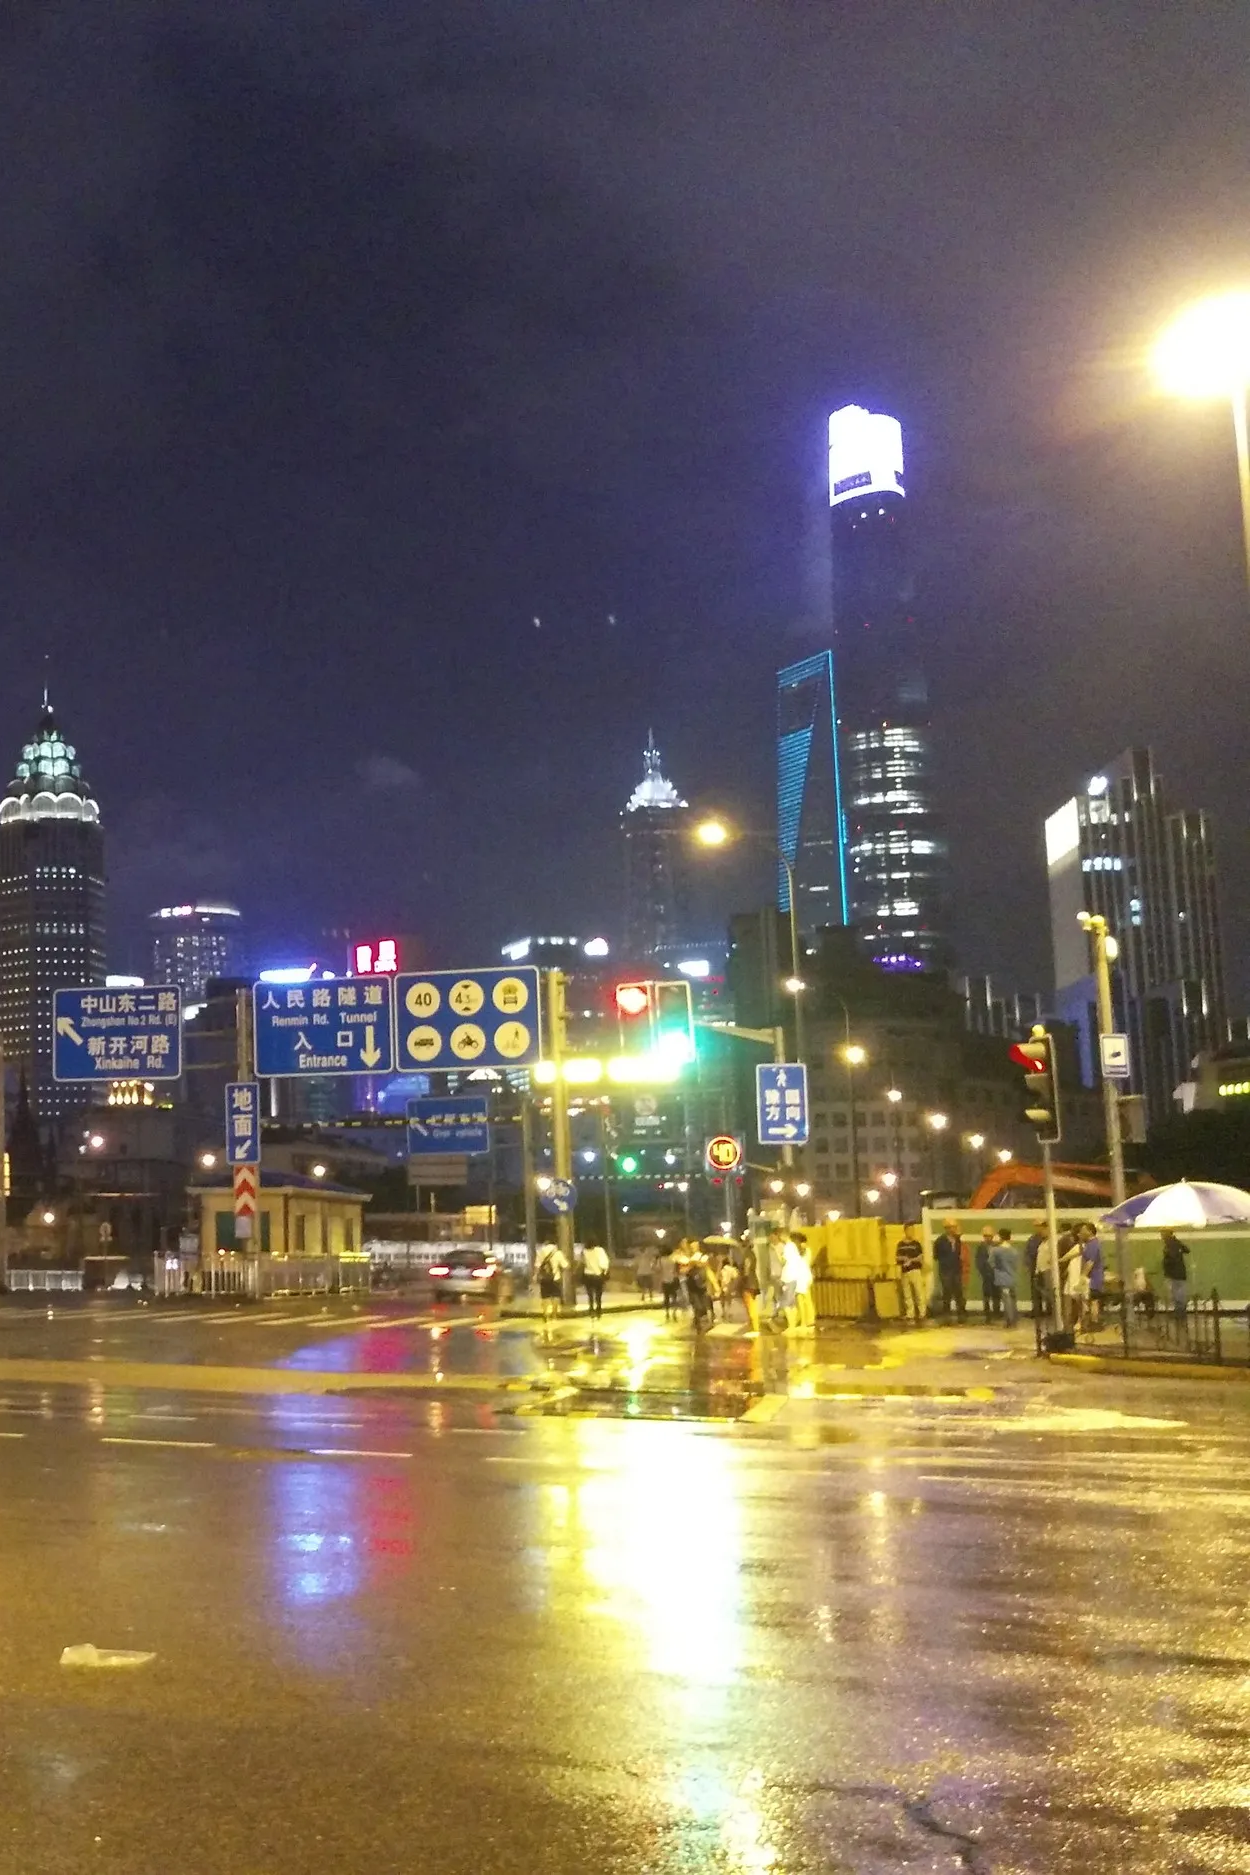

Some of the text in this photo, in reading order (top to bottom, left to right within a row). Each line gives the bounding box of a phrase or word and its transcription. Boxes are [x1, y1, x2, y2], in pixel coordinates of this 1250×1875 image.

[80, 991, 176, 1014] 中山东二路
[262, 985, 383, 1010] 人民路隧道
[414, 992, 432, 1006] 40
[272, 1011, 377, 1027] Renmin Rd. Tunnel
[87, 1034, 170, 1056] 新开河路
[294, 1031, 353, 1051] 入口
[146, 1055, 165, 1069] Rd.
[299, 1053, 348, 1069] Entrance
[232, 1087, 253, 1137] 地面
[712, 1143, 736, 1163] 40
